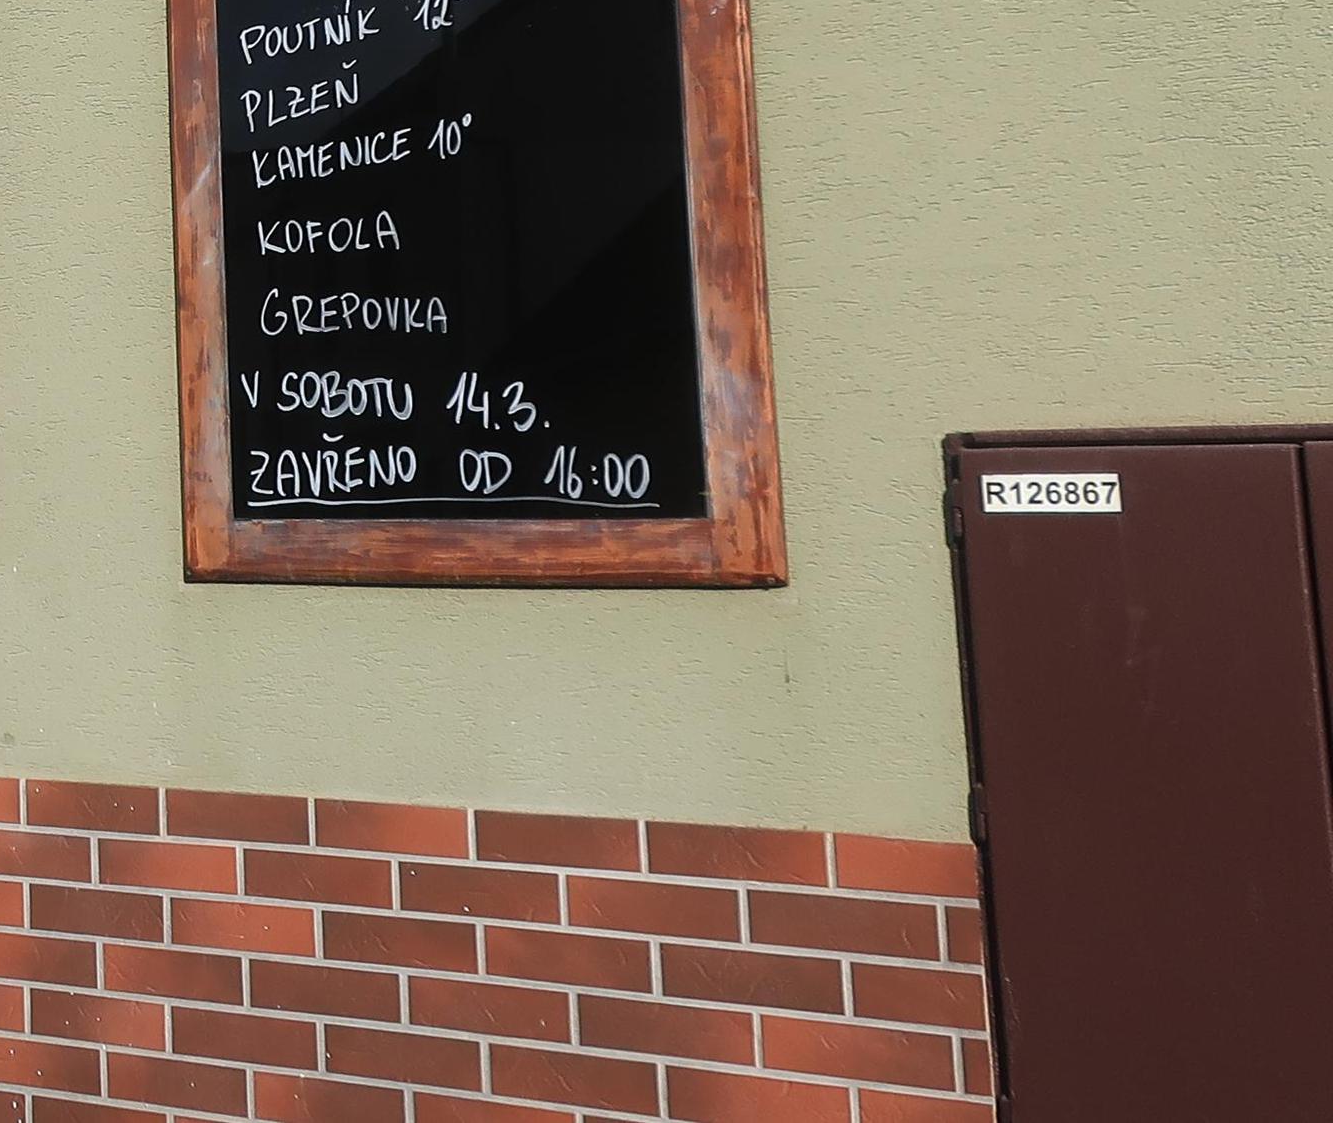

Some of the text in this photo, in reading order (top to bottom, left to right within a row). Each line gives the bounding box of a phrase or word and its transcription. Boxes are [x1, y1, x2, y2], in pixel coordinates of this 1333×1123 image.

[239, 59, 361, 133] PLZEŇ
[251, 127, 413, 190] KAMENICE
[257, 210, 401, 255] KOFOLA
[259, 288, 448, 337] GREPOVKA
[240, 370, 551, 433] V SOBOTU 14.3.
[249, 432, 651, 501] ZAVŘENO OD 16:00
[985, 481, 1118, 507] R126867
